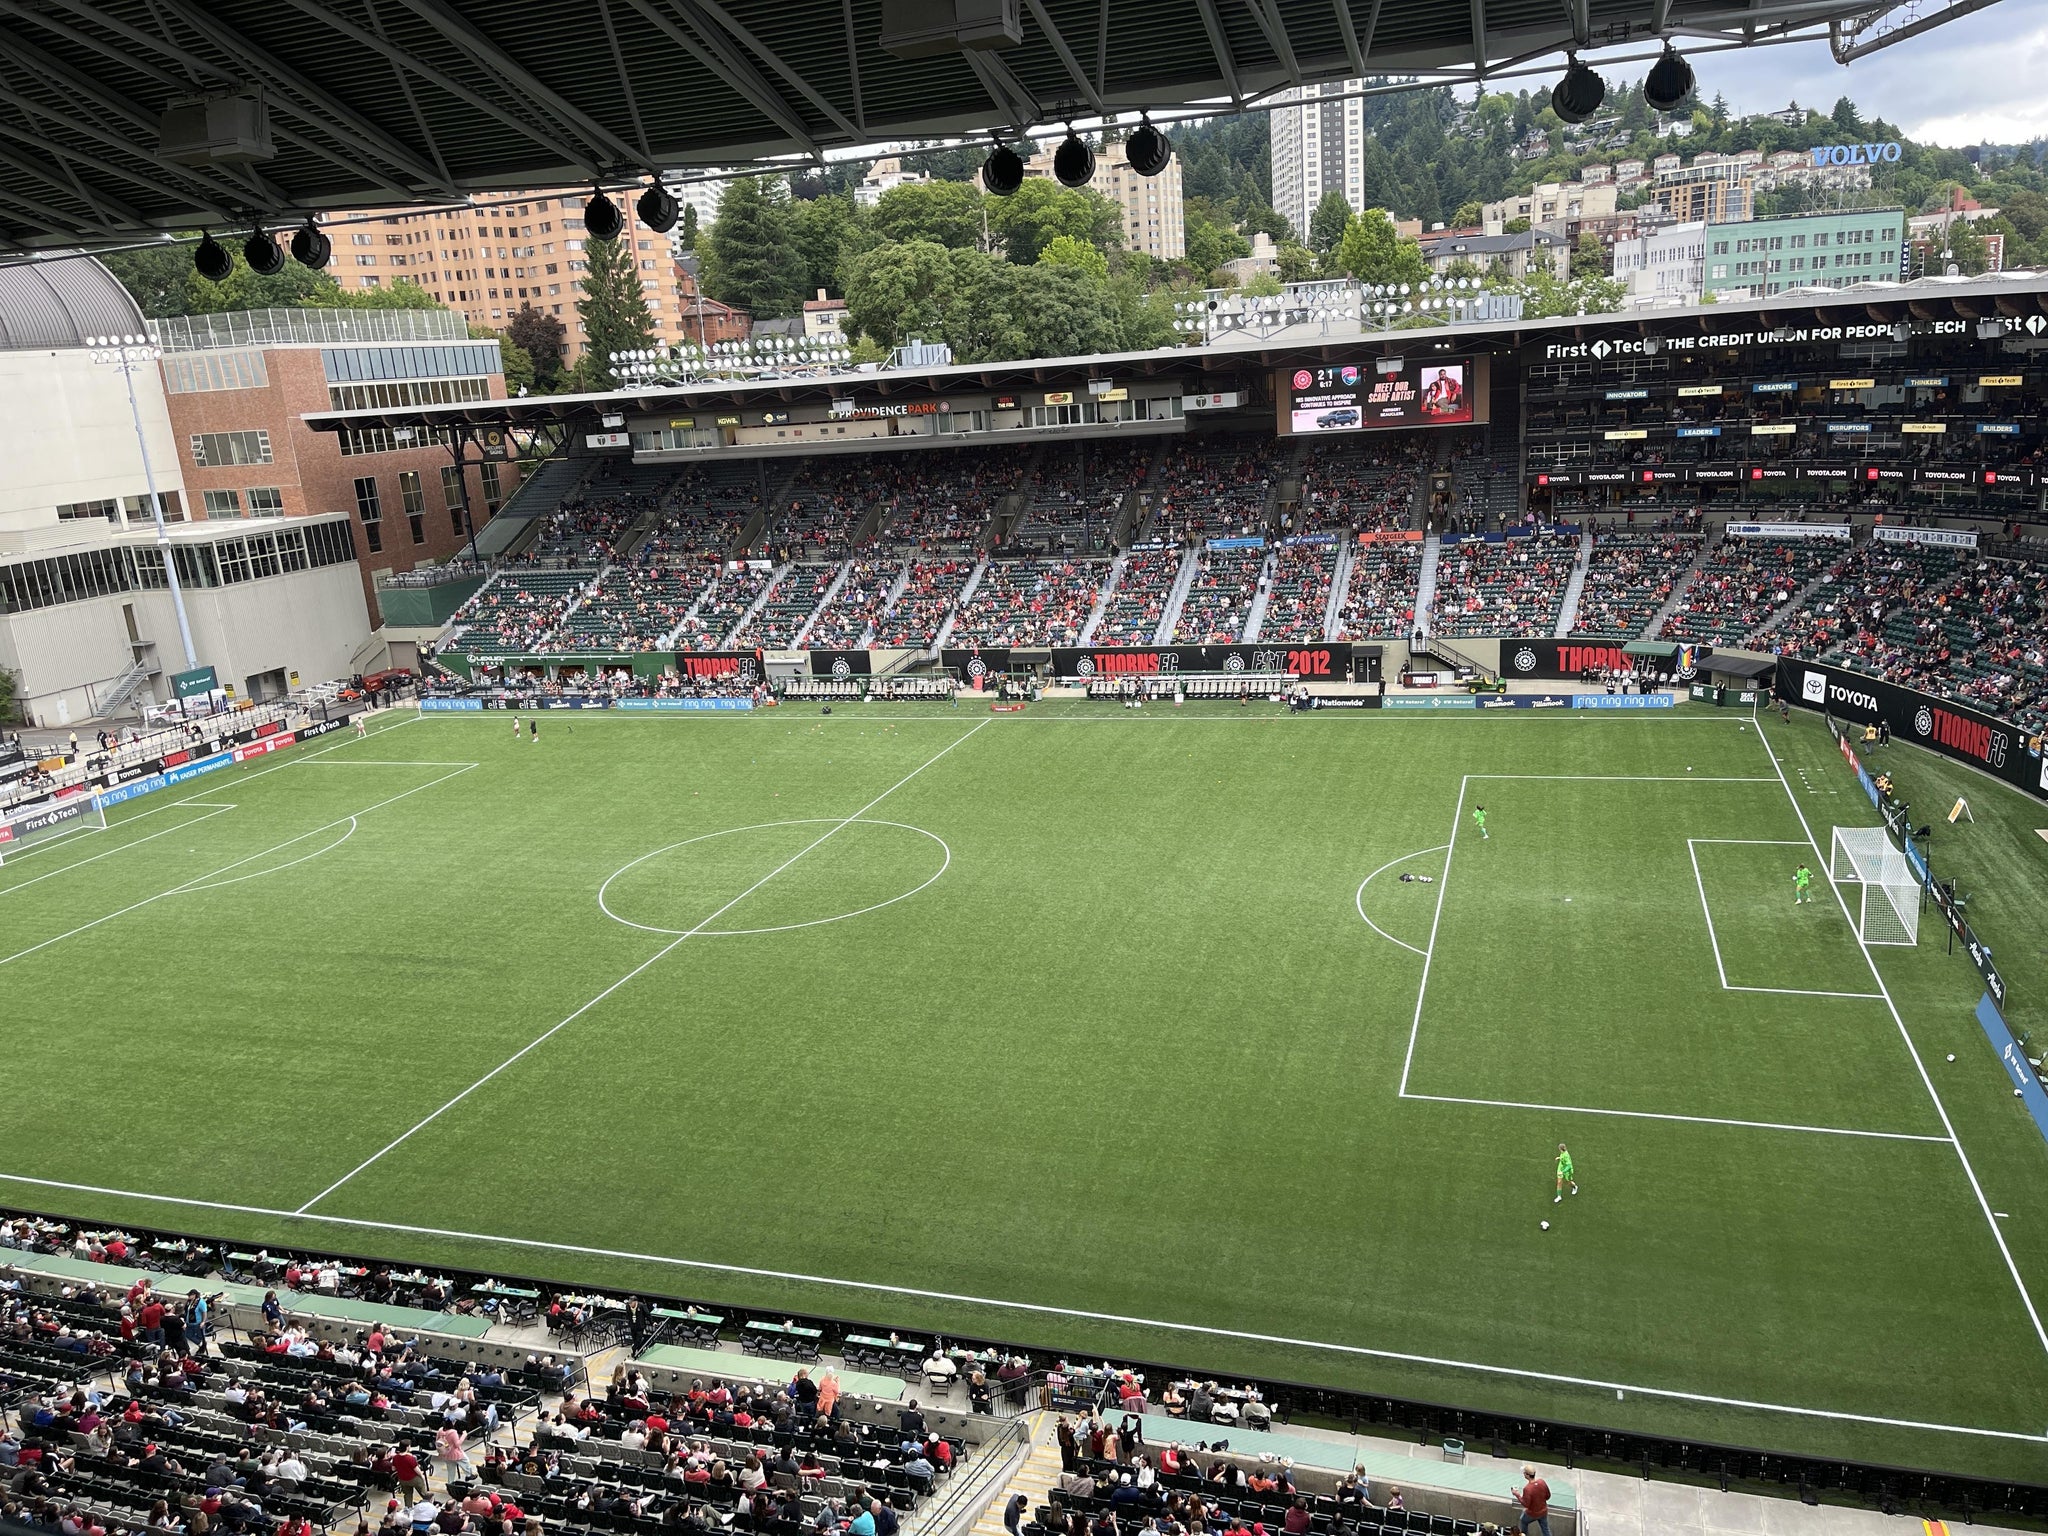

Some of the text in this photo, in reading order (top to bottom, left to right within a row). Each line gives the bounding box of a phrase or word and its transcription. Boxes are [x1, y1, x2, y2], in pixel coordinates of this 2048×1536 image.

[1810, 142, 1902, 167] VOLVO
[1547, 342, 1587, 359] First
[1666, 337, 1695, 350] THE
[1698, 332, 1754, 348] CREDIT
[1811, 327, 1842, 340] FOR
[1846, 324, 1898, 339] PEOPL
[1318, 369, 1333, 381] 2 1
[1374, 381, 1409, 393] MEET OUR
[1758, 383, 1792, 391] CREATORS
[1368, 390, 1416, 404] SCARF ARTIST
[1606, 391, 1647, 400] INNOVATORS
[1375, 533, 1407, 541] SEATGEEK
[1288, 650, 1331, 674] 2012
[1483, 699, 1516, 708] Tillamook
[1532, 699, 1565, 708] Tillamook
[1577, 696, 1669, 707] ring ring ring ring
[1829, 684, 1878, 712] TOYOTA
[424, 700, 480, 710] ring ring ring ring
[685, 700, 751, 710] ring ring ring ring
[304, 720, 340, 738] First Tech
[275, 737, 294, 747] TOYOTA
[244, 746, 264, 757] TOYOTA
[119, 767, 142, 779] TOYOTA
[180, 770, 198, 781] KAISER
[112, 790, 128, 801] ring
[133, 783, 149, 795] ring
[151, 777, 166, 788] ring
[5, 804, 31, 817] TOYOTA
[26, 806, 78, 831] First Tech
